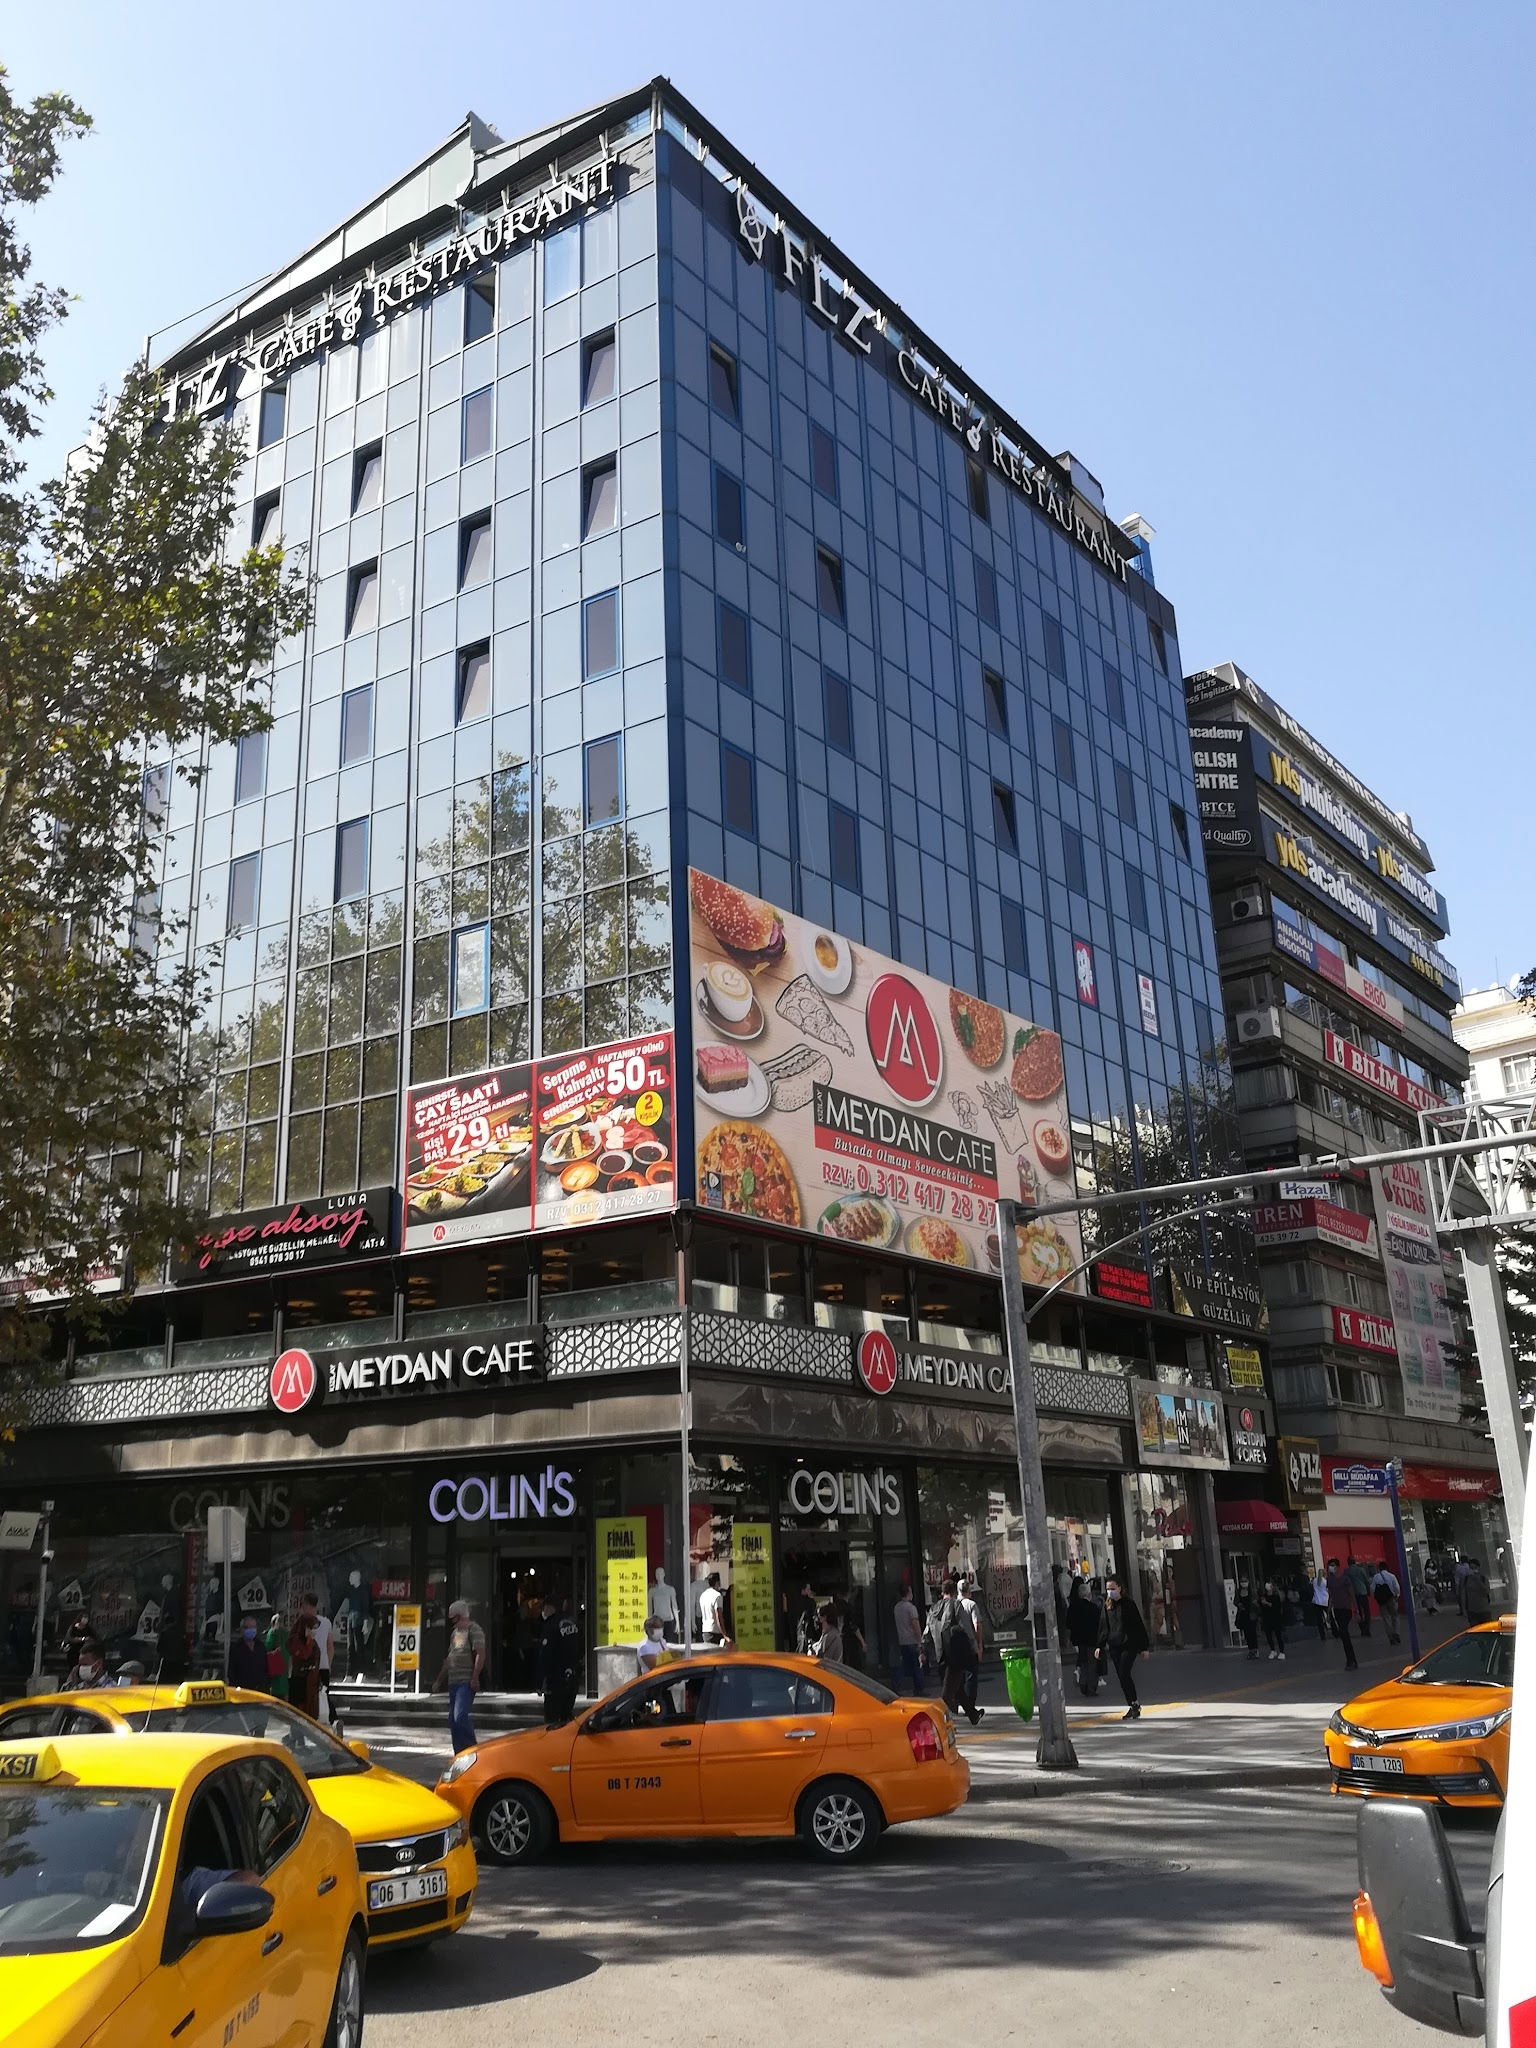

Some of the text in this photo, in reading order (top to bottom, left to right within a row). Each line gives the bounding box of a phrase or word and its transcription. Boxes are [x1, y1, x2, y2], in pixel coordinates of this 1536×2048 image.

[257, 308, 334, 374] CAFE
[372, 153, 618, 318] RESTAURANT
[781, 231, 1130, 583] FLZ CAFE RESTAURANT
[1194, 678, 1217, 692] IELTS
[1192, 751, 1238, 768] GLISH
[1213, 829, 1247, 843] Quality
[1275, 831, 1378, 937] ydsacademy
[1276, 919, 1313, 952] ANADOLU
[1363, 979, 1387, 1010] ERGO
[598, 1049, 635, 1064] HAFTANIN
[543, 1060, 587, 1091] Serpme
[557, 1067, 606, 1100] Kahvaltı
[606, 1056, 665, 1095] 50 TL
[1351, 1050, 1399, 1096] BİLİM
[491, 1092, 528, 1111] ARASINDA
[585, 1081, 605, 1099] ÇAY
[644, 1094, 654, 1110] 2
[415, 1078, 500, 1128] ÇAY SAATİ
[424, 1134, 445, 1151] KİŞİ
[447, 1117, 491, 1157] 29
[826, 1091, 994, 1176] MEYDAN CAFE
[424, 1146, 447, 1163] BAŞI
[834, 1137, 873, 1160] Burada
[876, 1149, 912, 1169] Olmayı
[647, 1190, 661, 1203] 27
[856, 1163, 909, 1203] 0.312
[914, 1180, 946, 1213] 417
[951, 1190, 973, 1222] 28
[977, 1198, 997, 1226] 27
[1284, 1182, 1329, 1195] Hazal
[1392, 1186, 1427, 1215] KURS
[328, 1193, 368, 1210] LUNA
[1251, 1203, 1303, 1225] TREN
[260, 1203, 368, 1249] aksoy
[1276, 1231, 1287, 1241] 39
[1290, 1231, 1299, 1239] 72
[1207, 1278, 1261, 1305] EPİLASYON
[1203, 1302, 1252, 1327] GÜZELLİK
[1359, 1314, 1397, 1350] BİLİM
[335, 1339, 534, 1392] MEYDAN CAFE
[904, 1352, 1014, 1393] MEYDAN CA
[1235, 1432, 1267, 1448] MEYDAN
[1242, 1449, 1262, 1463] CAFE
[1299, 1452, 1322, 1478] FLZ
[429, 1464, 577, 1523] COLIN'S
[789, 1466, 901, 1516] COLIN'S
[607, 1529, 636, 1547] FİNAL
[66, 1590, 80, 1604] 20
[247, 1588, 264, 1603] 20
[380, 1582, 406, 1597] JEANS
[398, 1634, 416, 1652] 30
[1355, 1756, 1402, 1772] 06 T 1203
[624, 1777, 631, 1789] T
[634, 1776, 662, 1789] 7343
[379, 1875, 443, 1903] 06 T 3161
